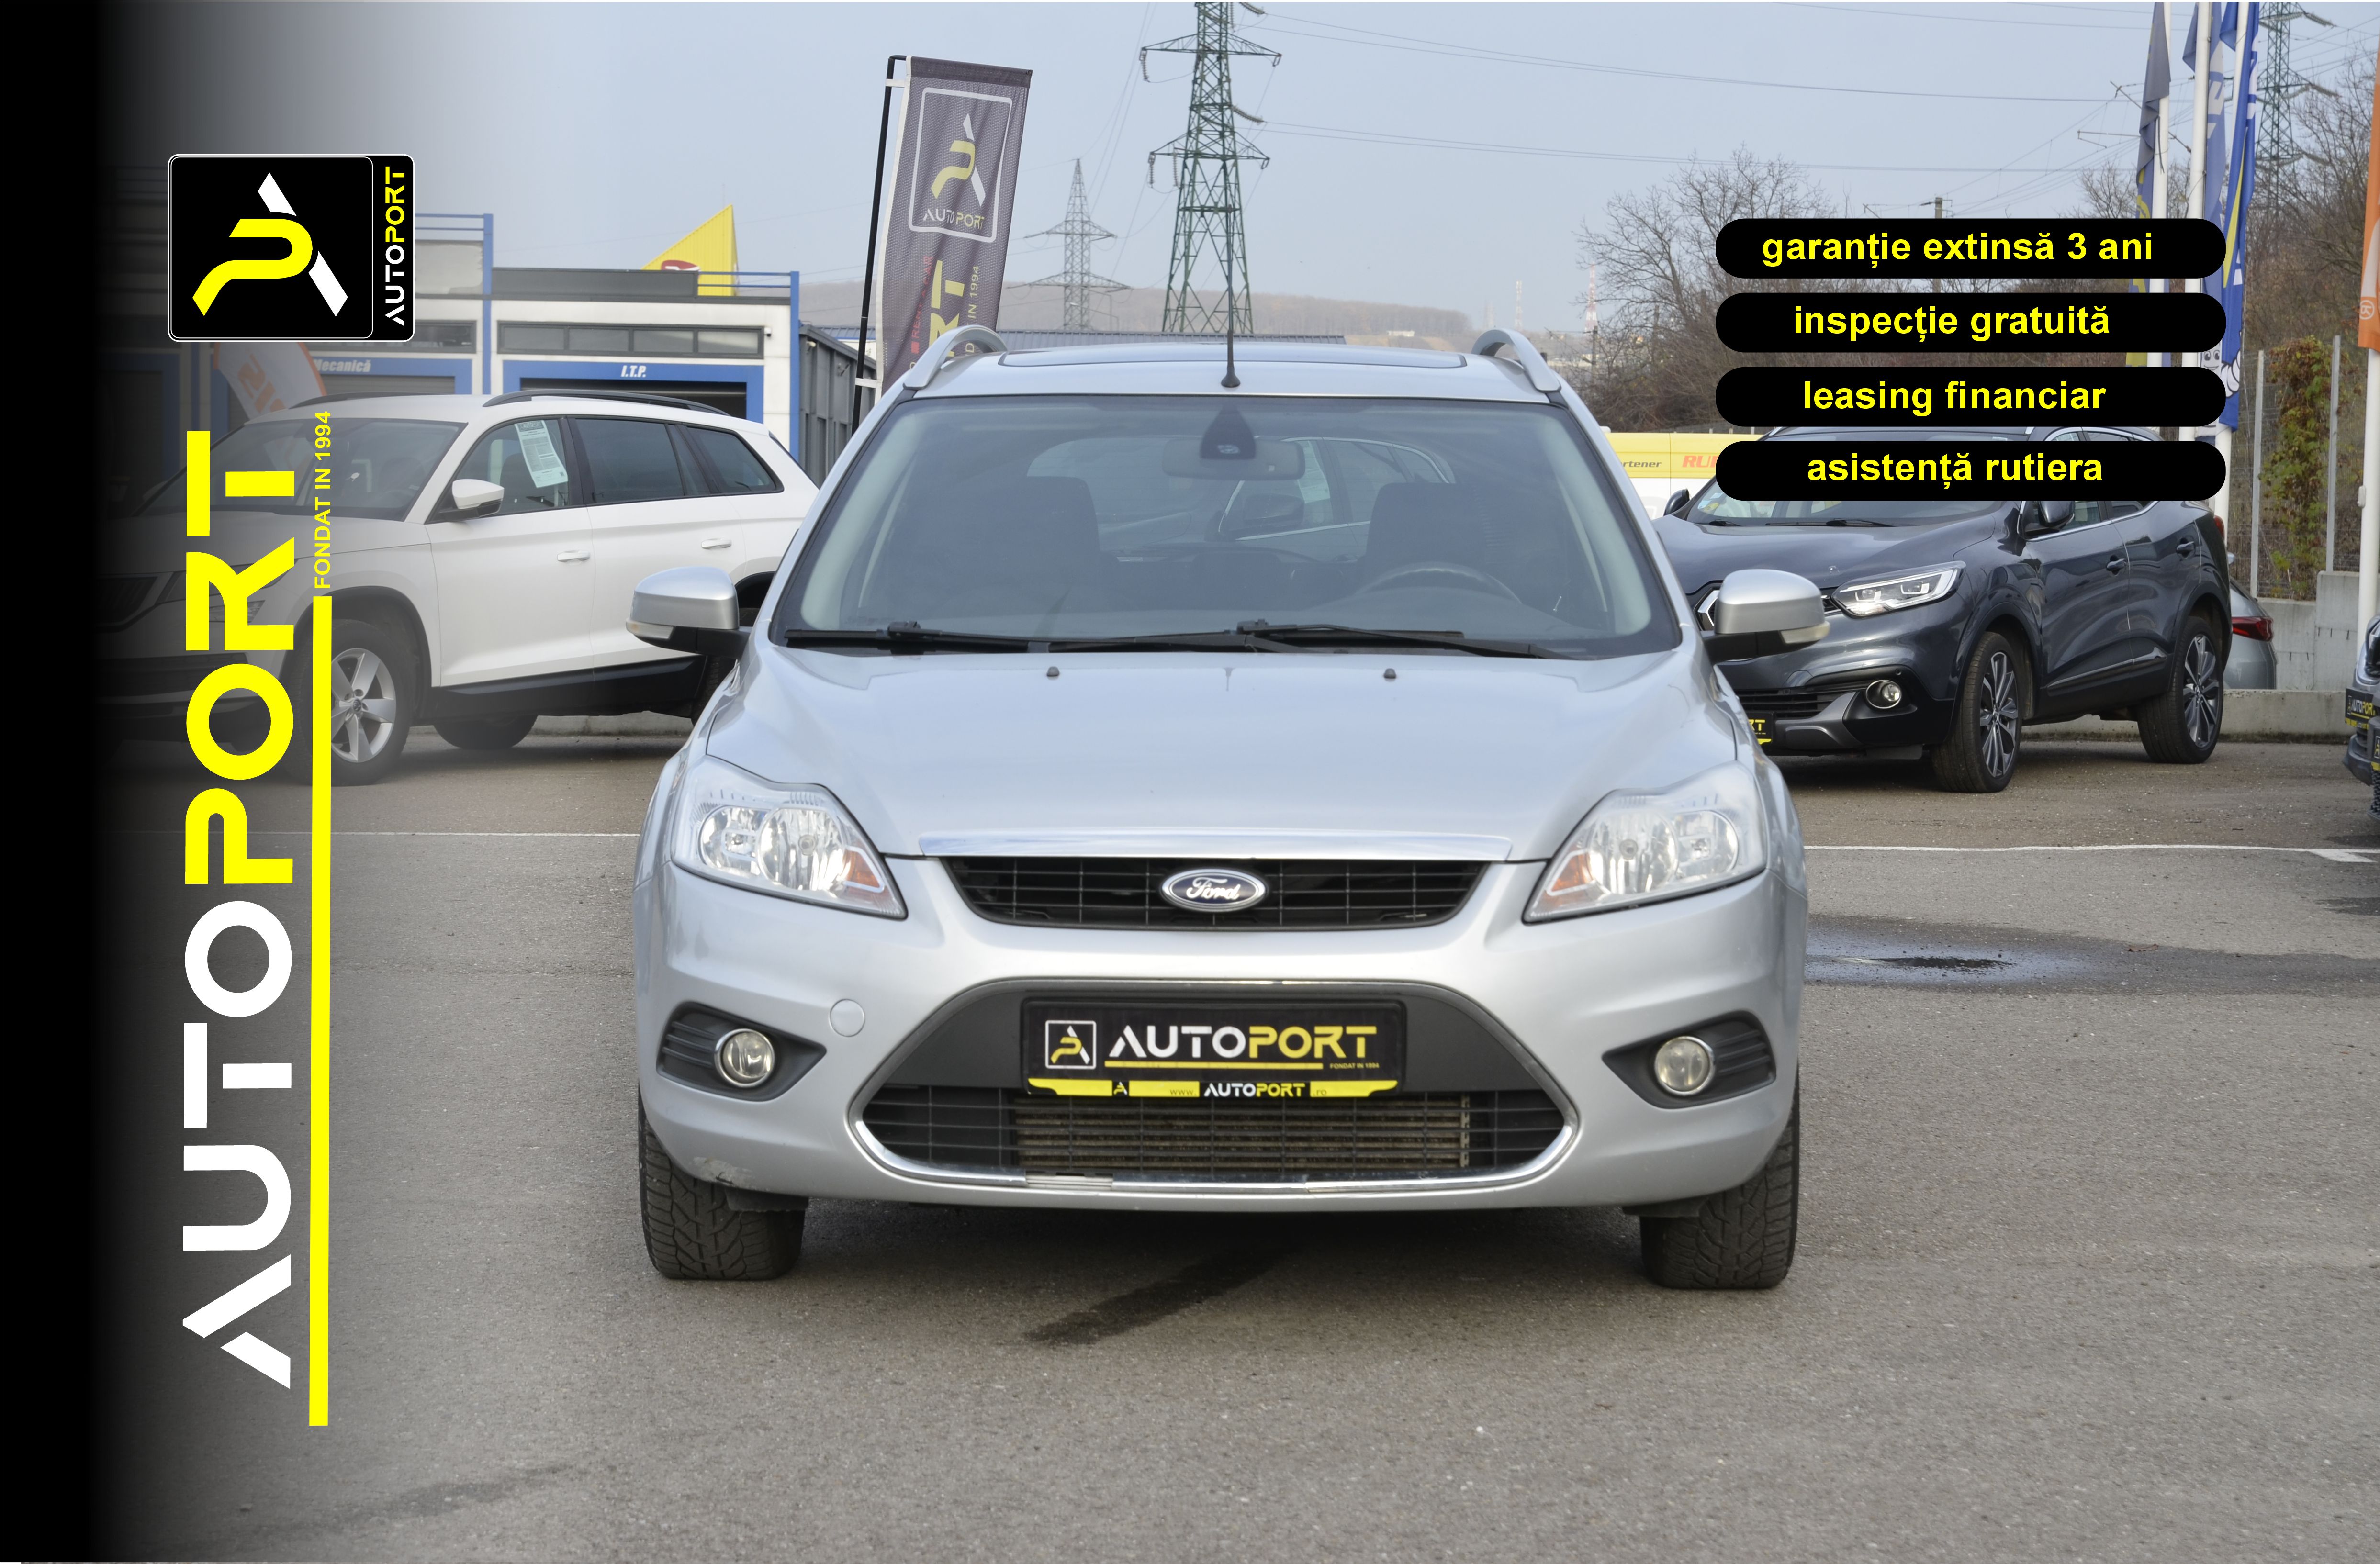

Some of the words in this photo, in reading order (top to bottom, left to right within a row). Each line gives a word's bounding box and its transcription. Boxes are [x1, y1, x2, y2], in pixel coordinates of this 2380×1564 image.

[923, 208, 985, 229] AUTOPORT
[969, 265, 979, 298] 1994
[967, 303, 977, 319] IN
[621, 365, 646, 378] I.T.P.
[1186, 877, 1241, 900] Ford
[1109, 1025, 1377, 1059] AUTOPORT
[1204, 1083, 1306, 1097] AUTOPORT
